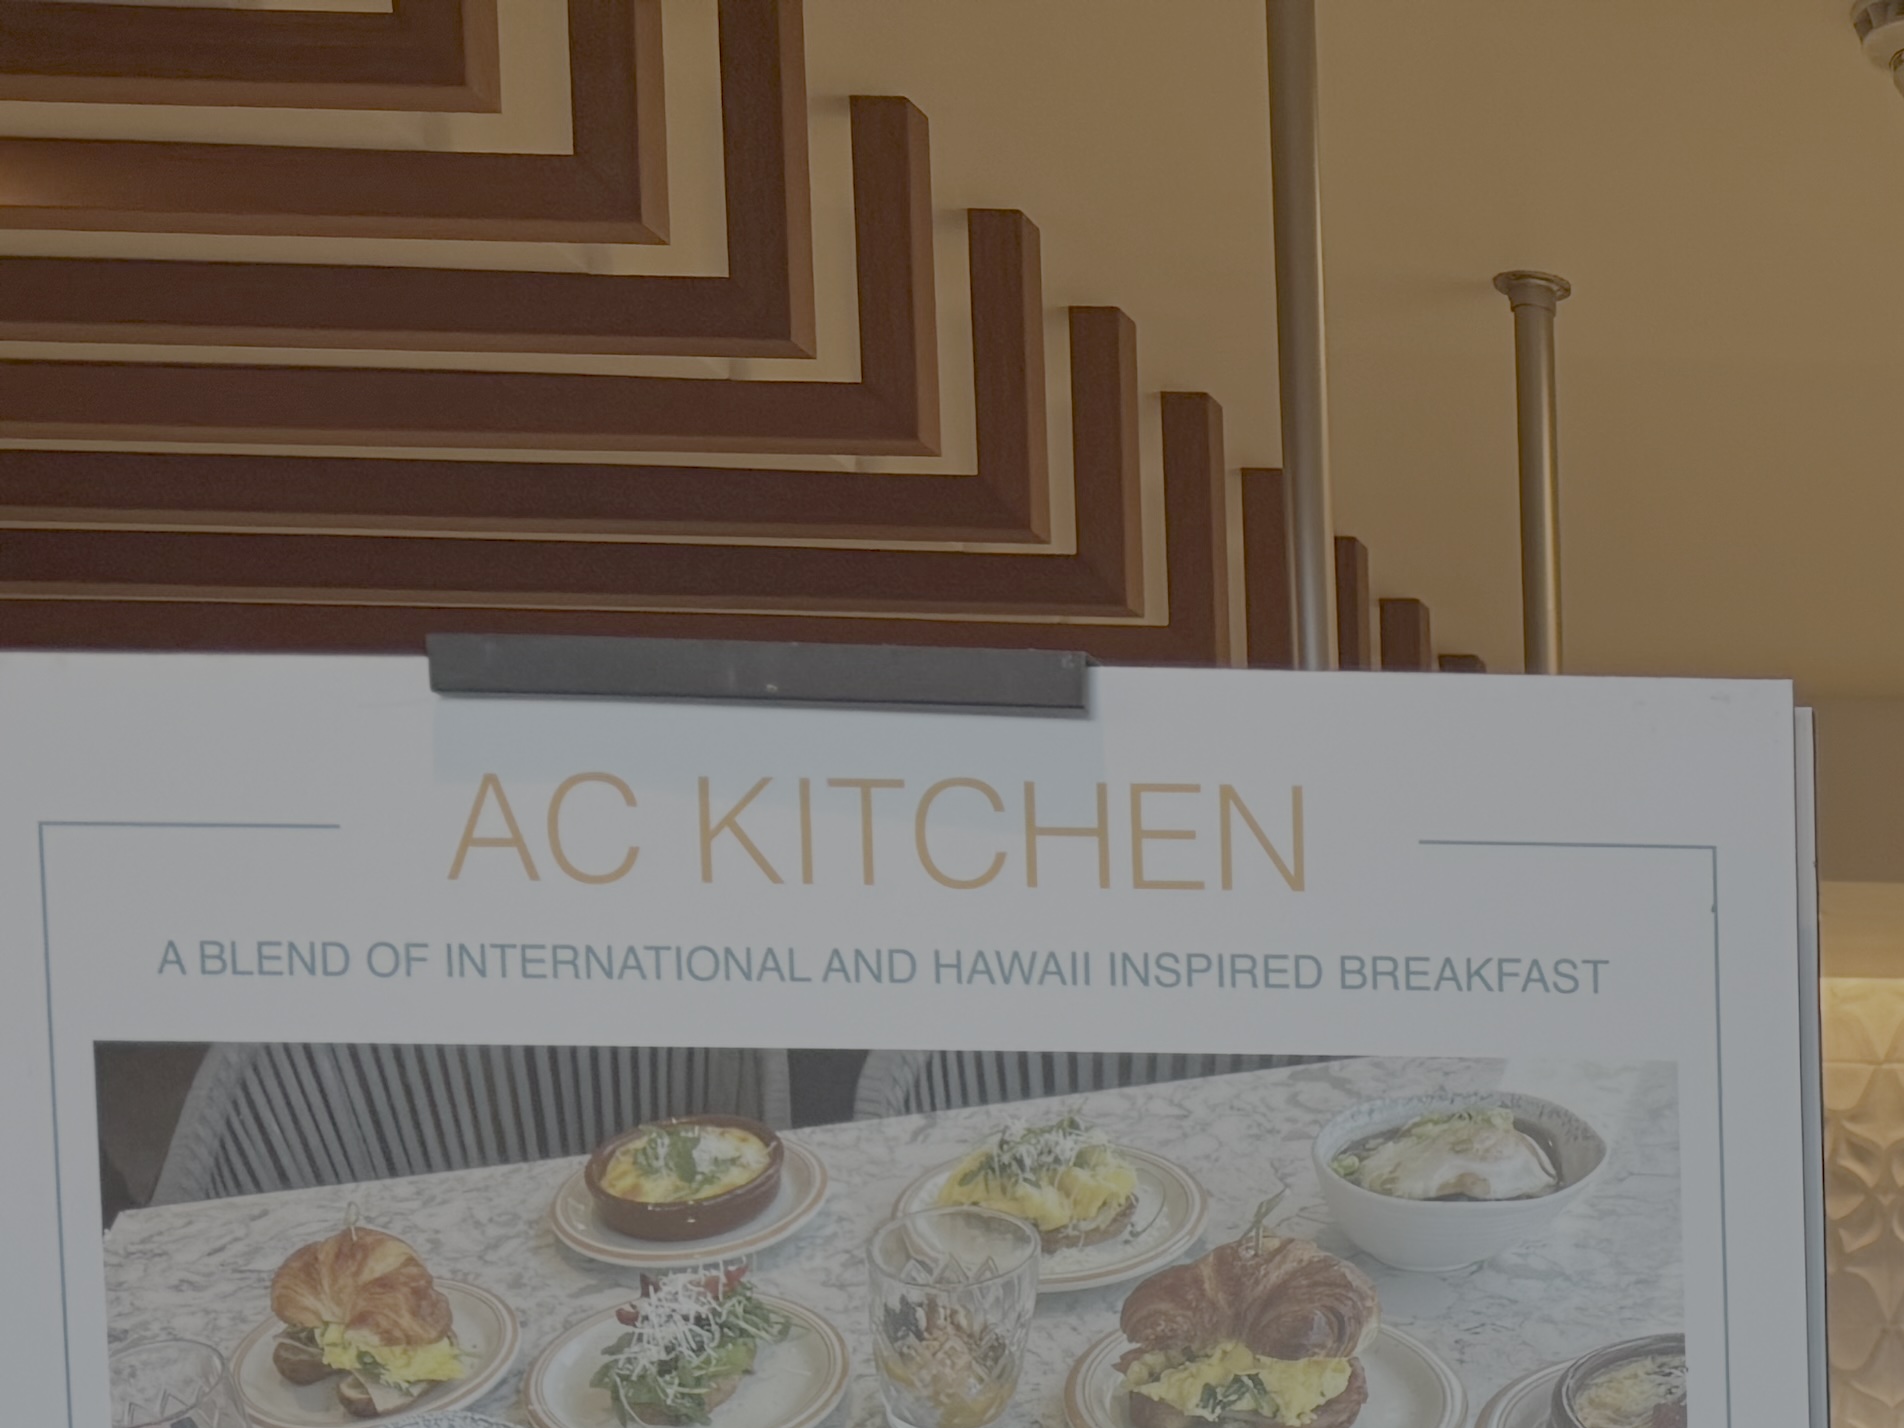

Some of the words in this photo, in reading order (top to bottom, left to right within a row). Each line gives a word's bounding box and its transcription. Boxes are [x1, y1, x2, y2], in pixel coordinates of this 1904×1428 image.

[448, 772, 639, 885] AC
[698, 777, 1305, 892] KITCHEN
[157, 940, 187, 975] A
[199, 940, 351, 977] BLEND
[366, 941, 429, 978] OF
[446, 943, 812, 982] INTERNATIONAL
[822, 948, 917, 984] AND
[934, 949, 1091, 986] HAWAII
[1109, 952, 1323, 989] INSPIRED
[1340, 955, 1610, 994] BREAKFAST
